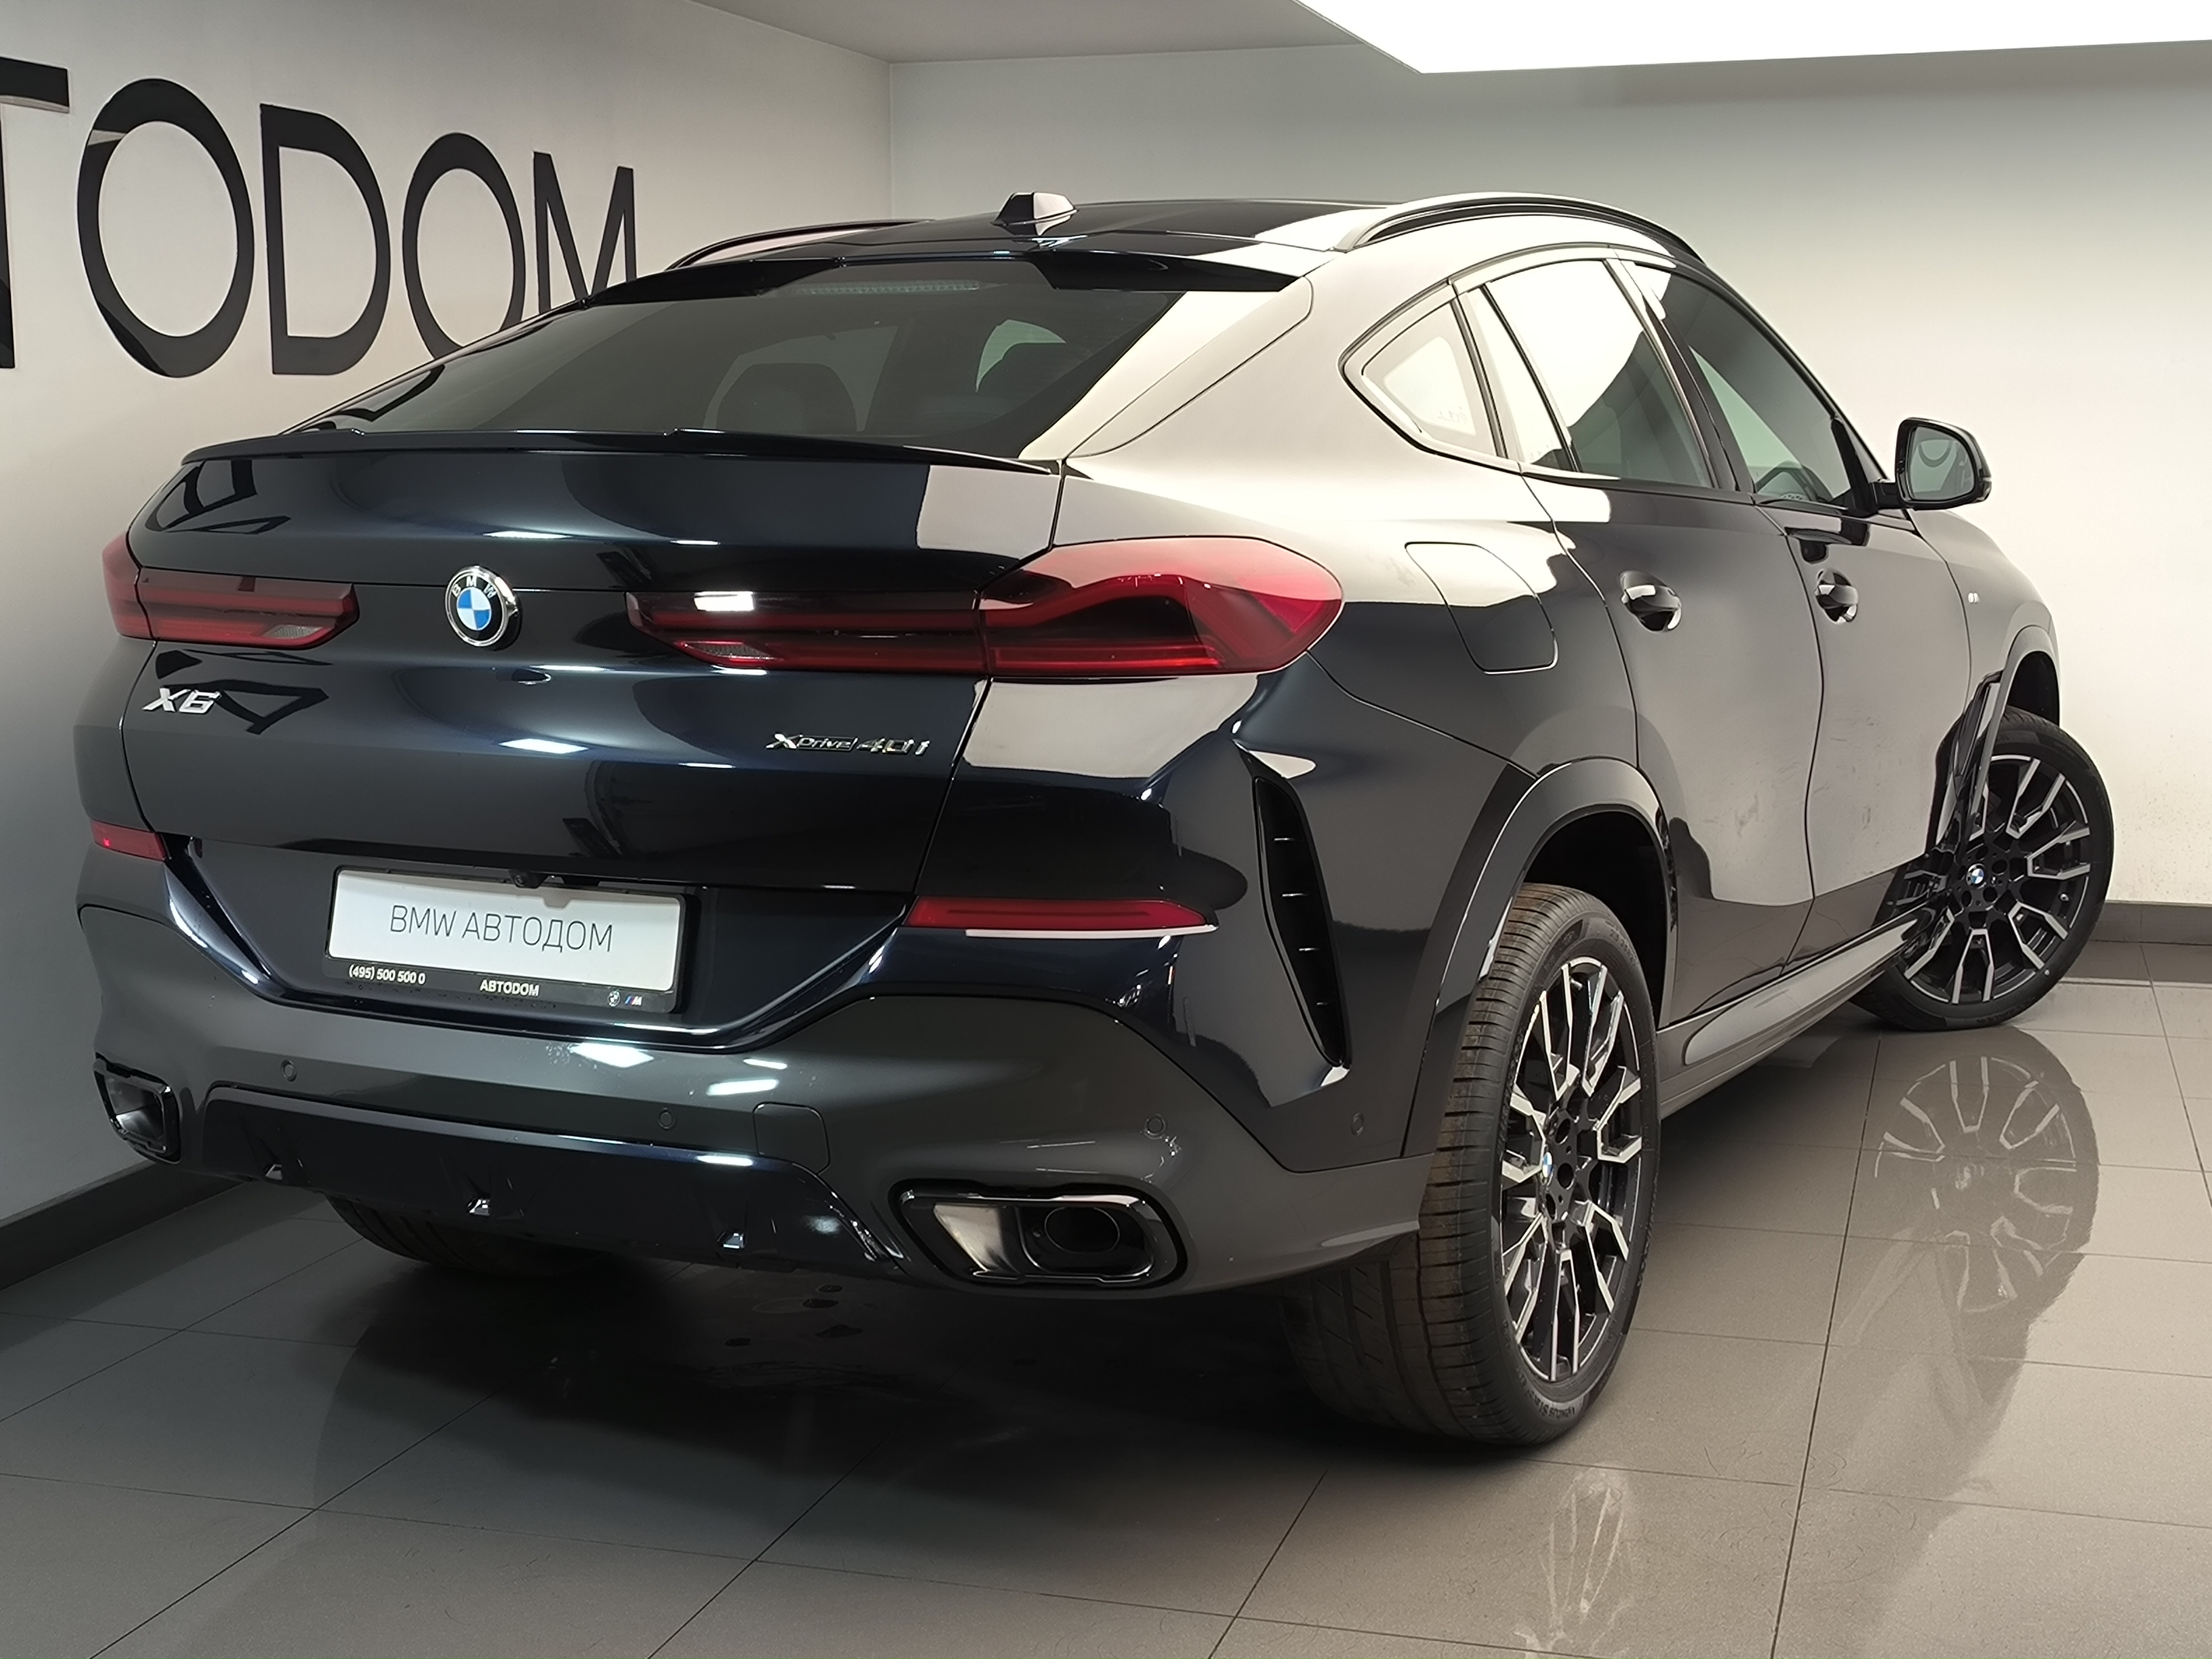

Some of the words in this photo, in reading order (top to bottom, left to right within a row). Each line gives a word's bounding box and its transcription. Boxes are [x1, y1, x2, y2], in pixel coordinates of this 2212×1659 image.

[451, 576, 497, 598] BMW
[142, 687, 221, 713] X6
[390, 905, 457, 937] BMW
[462, 912, 612, 953] АВТОДОМ
[349, 964, 375, 980] (495)
[377, 968, 395, 982] 500
[397, 971, 417, 984] 500
[418, 972, 426, 985] 0
